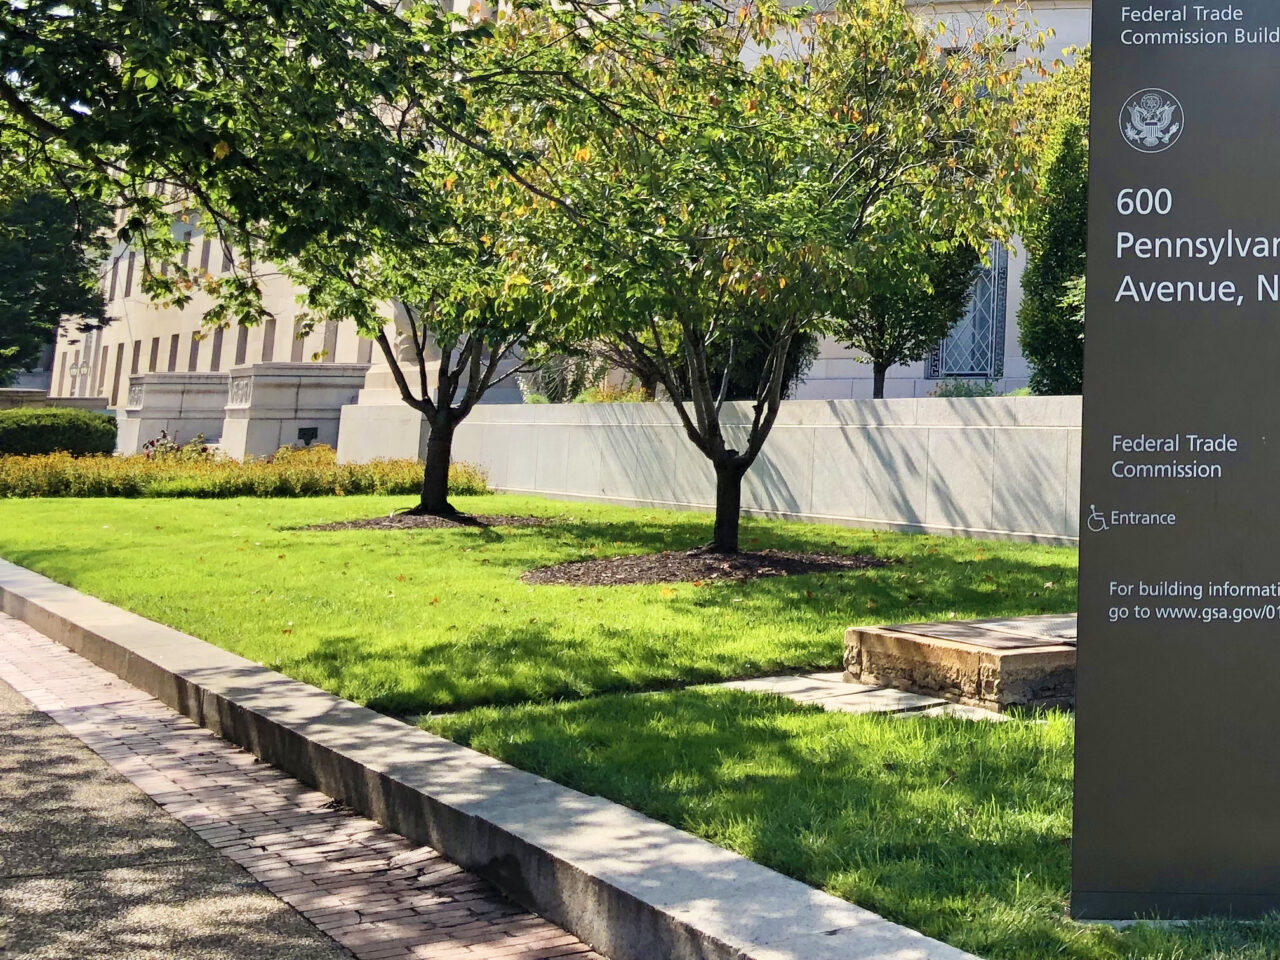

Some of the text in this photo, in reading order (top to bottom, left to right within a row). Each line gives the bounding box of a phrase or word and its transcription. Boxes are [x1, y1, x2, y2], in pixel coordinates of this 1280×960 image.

[1121, 4, 1244, 22] Federal Trade
[1120, 27, 1228, 45] Commission
[1116, 187, 1172, 215] 600
[1114, 275, 1244, 306] Avenue,
[1112, 433, 1238, 452] Federal Trade
[1111, 459, 1222, 478] Commission
[1111, 510, 1176, 525] Entrance
[1109, 581, 1135, 596] For
[1139, 580, 1203, 600] building
[1108, 607, 1129, 622] go
[1133, 605, 1151, 619] to
